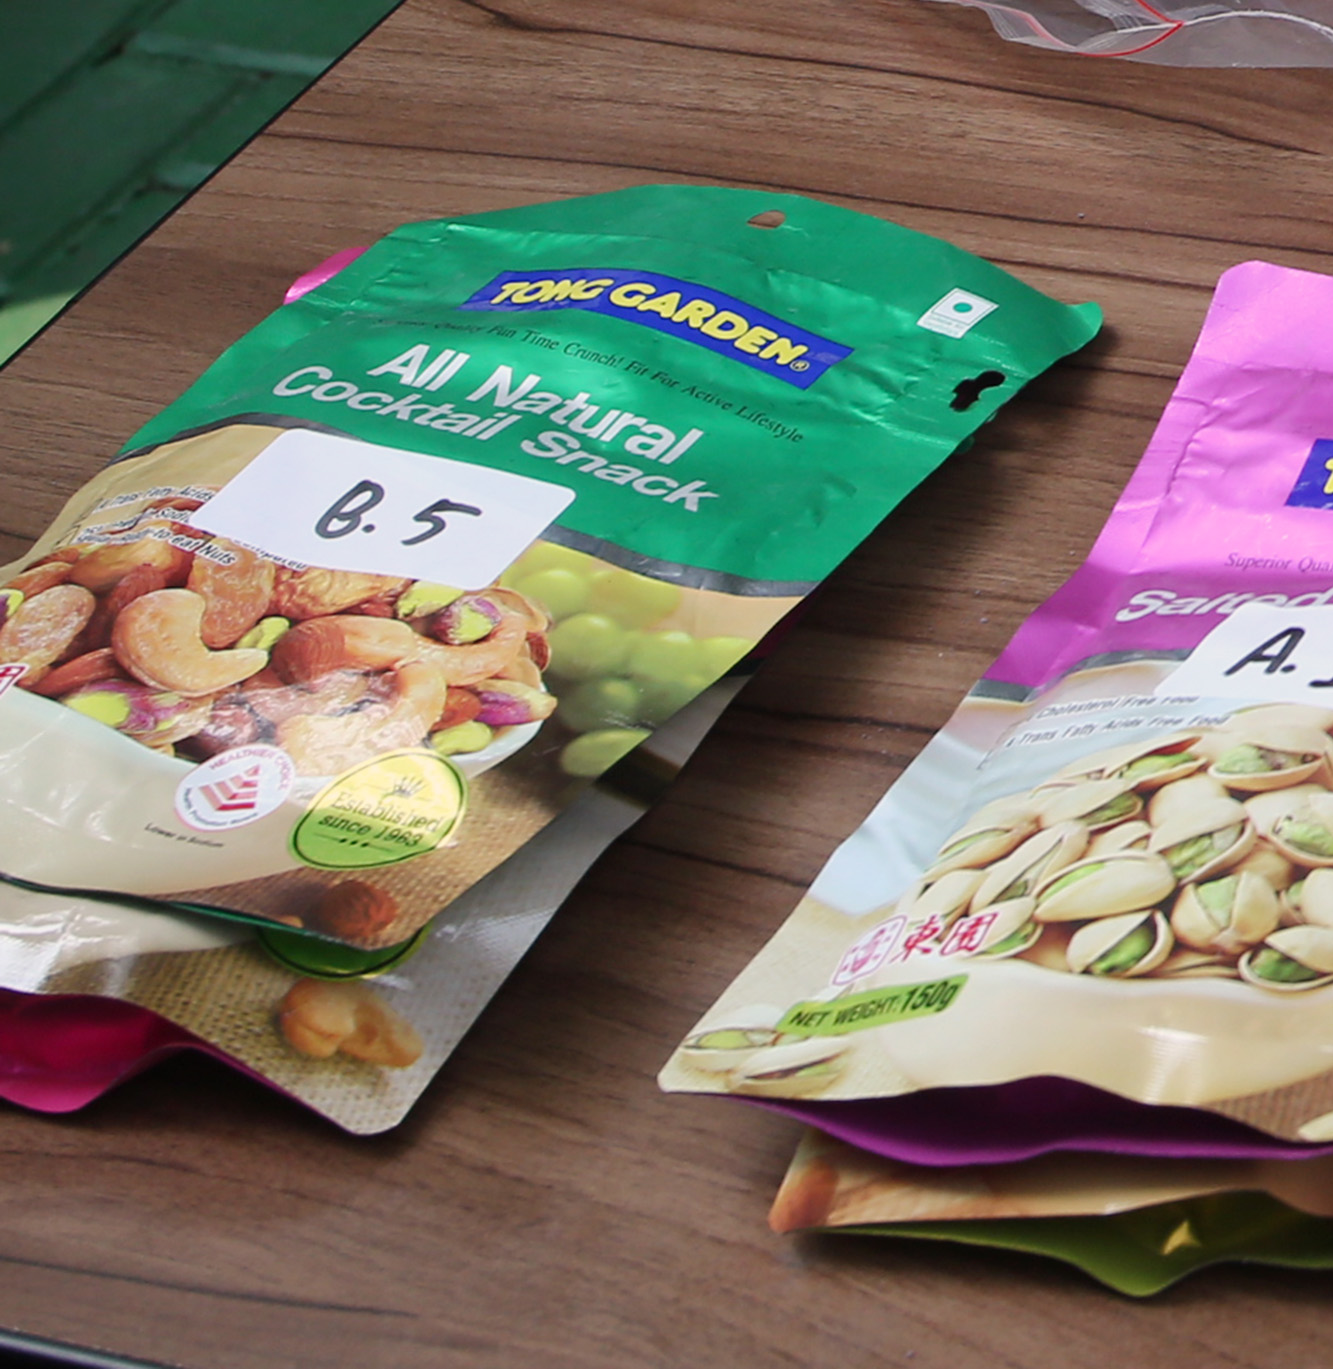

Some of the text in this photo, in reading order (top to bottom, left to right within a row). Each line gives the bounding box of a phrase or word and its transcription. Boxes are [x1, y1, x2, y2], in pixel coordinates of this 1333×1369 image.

[491, 276, 809, 365] TONG GARDEN
[367, 343, 704, 466] All Natural
[521, 329, 560, 351] Time
[563, 342, 623, 369] Crunch!
[625, 360, 651, 376] Fit
[651, 370, 681, 388] For
[682, 385, 733, 411] Active
[736, 404, 803, 444] Lifestyle
[273, 365, 719, 513] Cocktail Snack
[203, 543, 238, 566] Nuts
[1225, 552, 1291, 571] Superior
[1037, 698, 1121, 719] Cholesterol
[1122, 696, 1157, 708] Free
[1020, 729, 1059, 744] Trans
[1065, 725, 1096, 738] Fatty
[1103, 717, 1144, 731] Acids
[1150, 716, 1184, 727] Free
[1188, 715, 1232, 727] Food
[319, 813, 424, 848] since 1963
[331, 792, 443, 833] Established
[790, 980, 959, 1027] NET WEIGHT: 150g
